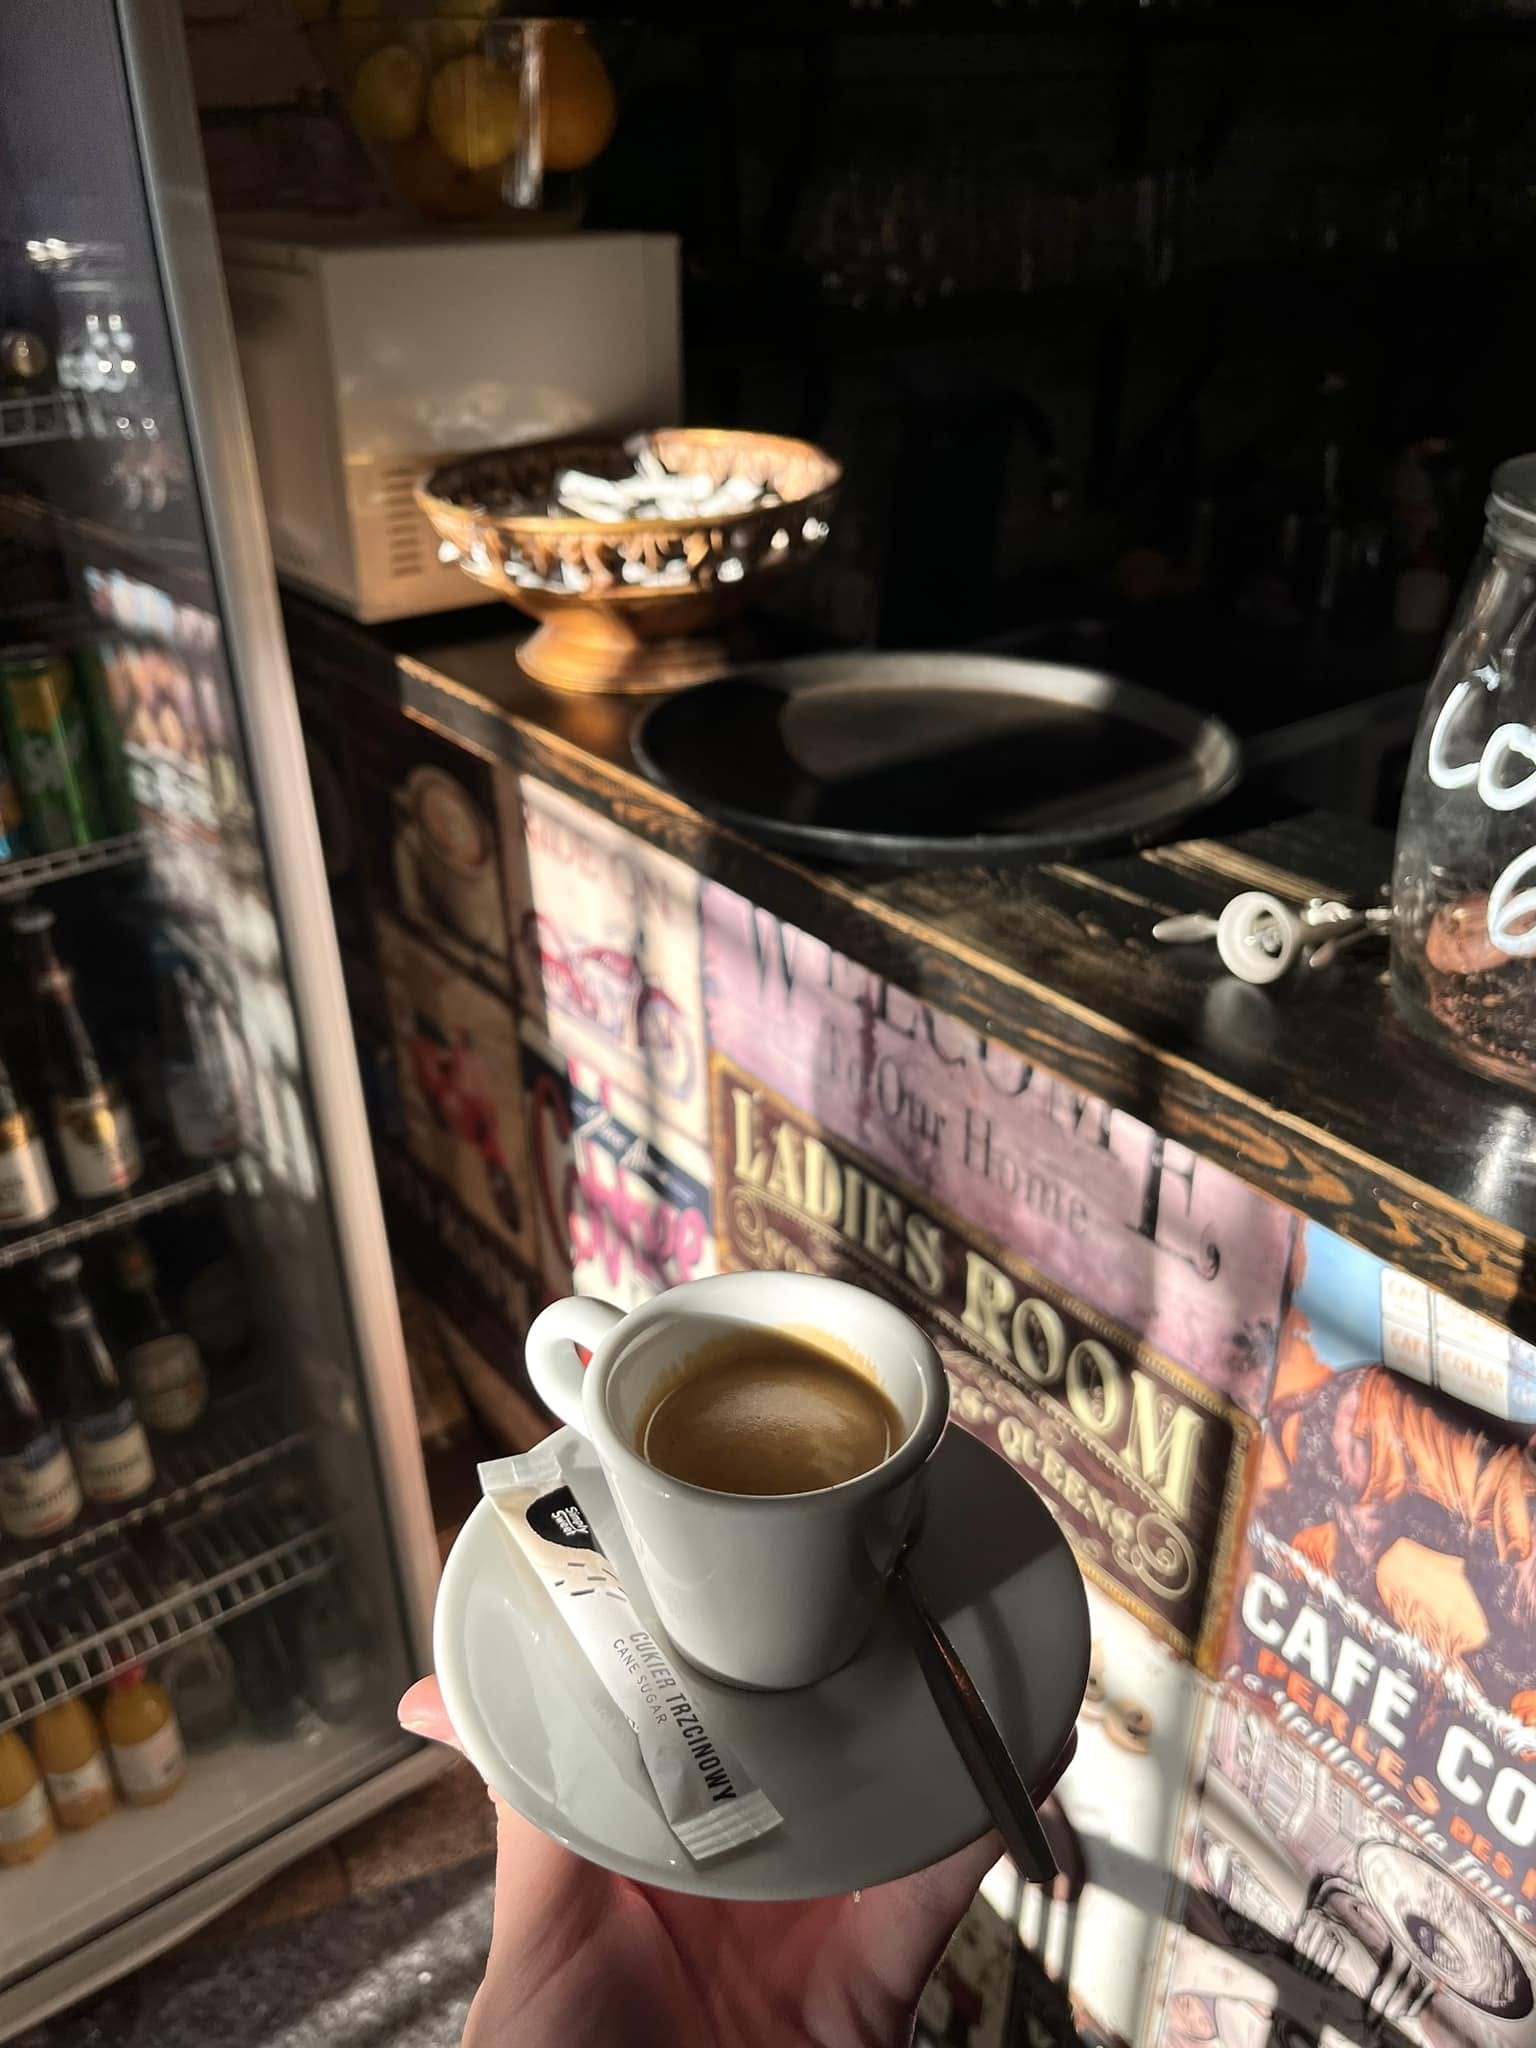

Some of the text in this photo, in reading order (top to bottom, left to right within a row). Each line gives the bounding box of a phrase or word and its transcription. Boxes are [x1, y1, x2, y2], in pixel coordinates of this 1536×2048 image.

[877, 1053, 947, 1149] Our
[961, 1105, 1088, 1239] Home
[731, 1088, 945, 1297] LADIES
[960, 1249, 1204, 1524] ROOM
[551, 1510, 577, 1537] Sweet
[565, 1506, 589, 1534] Simply
[612, 1639, 667, 1726] CANE SUGAR
[629, 1631, 737, 1803] CUKIER TRZCINOWY
[1242, 1571, 1419, 1750] CAFÉ
[1257, 1648, 1514, 1881] PERLES DES
